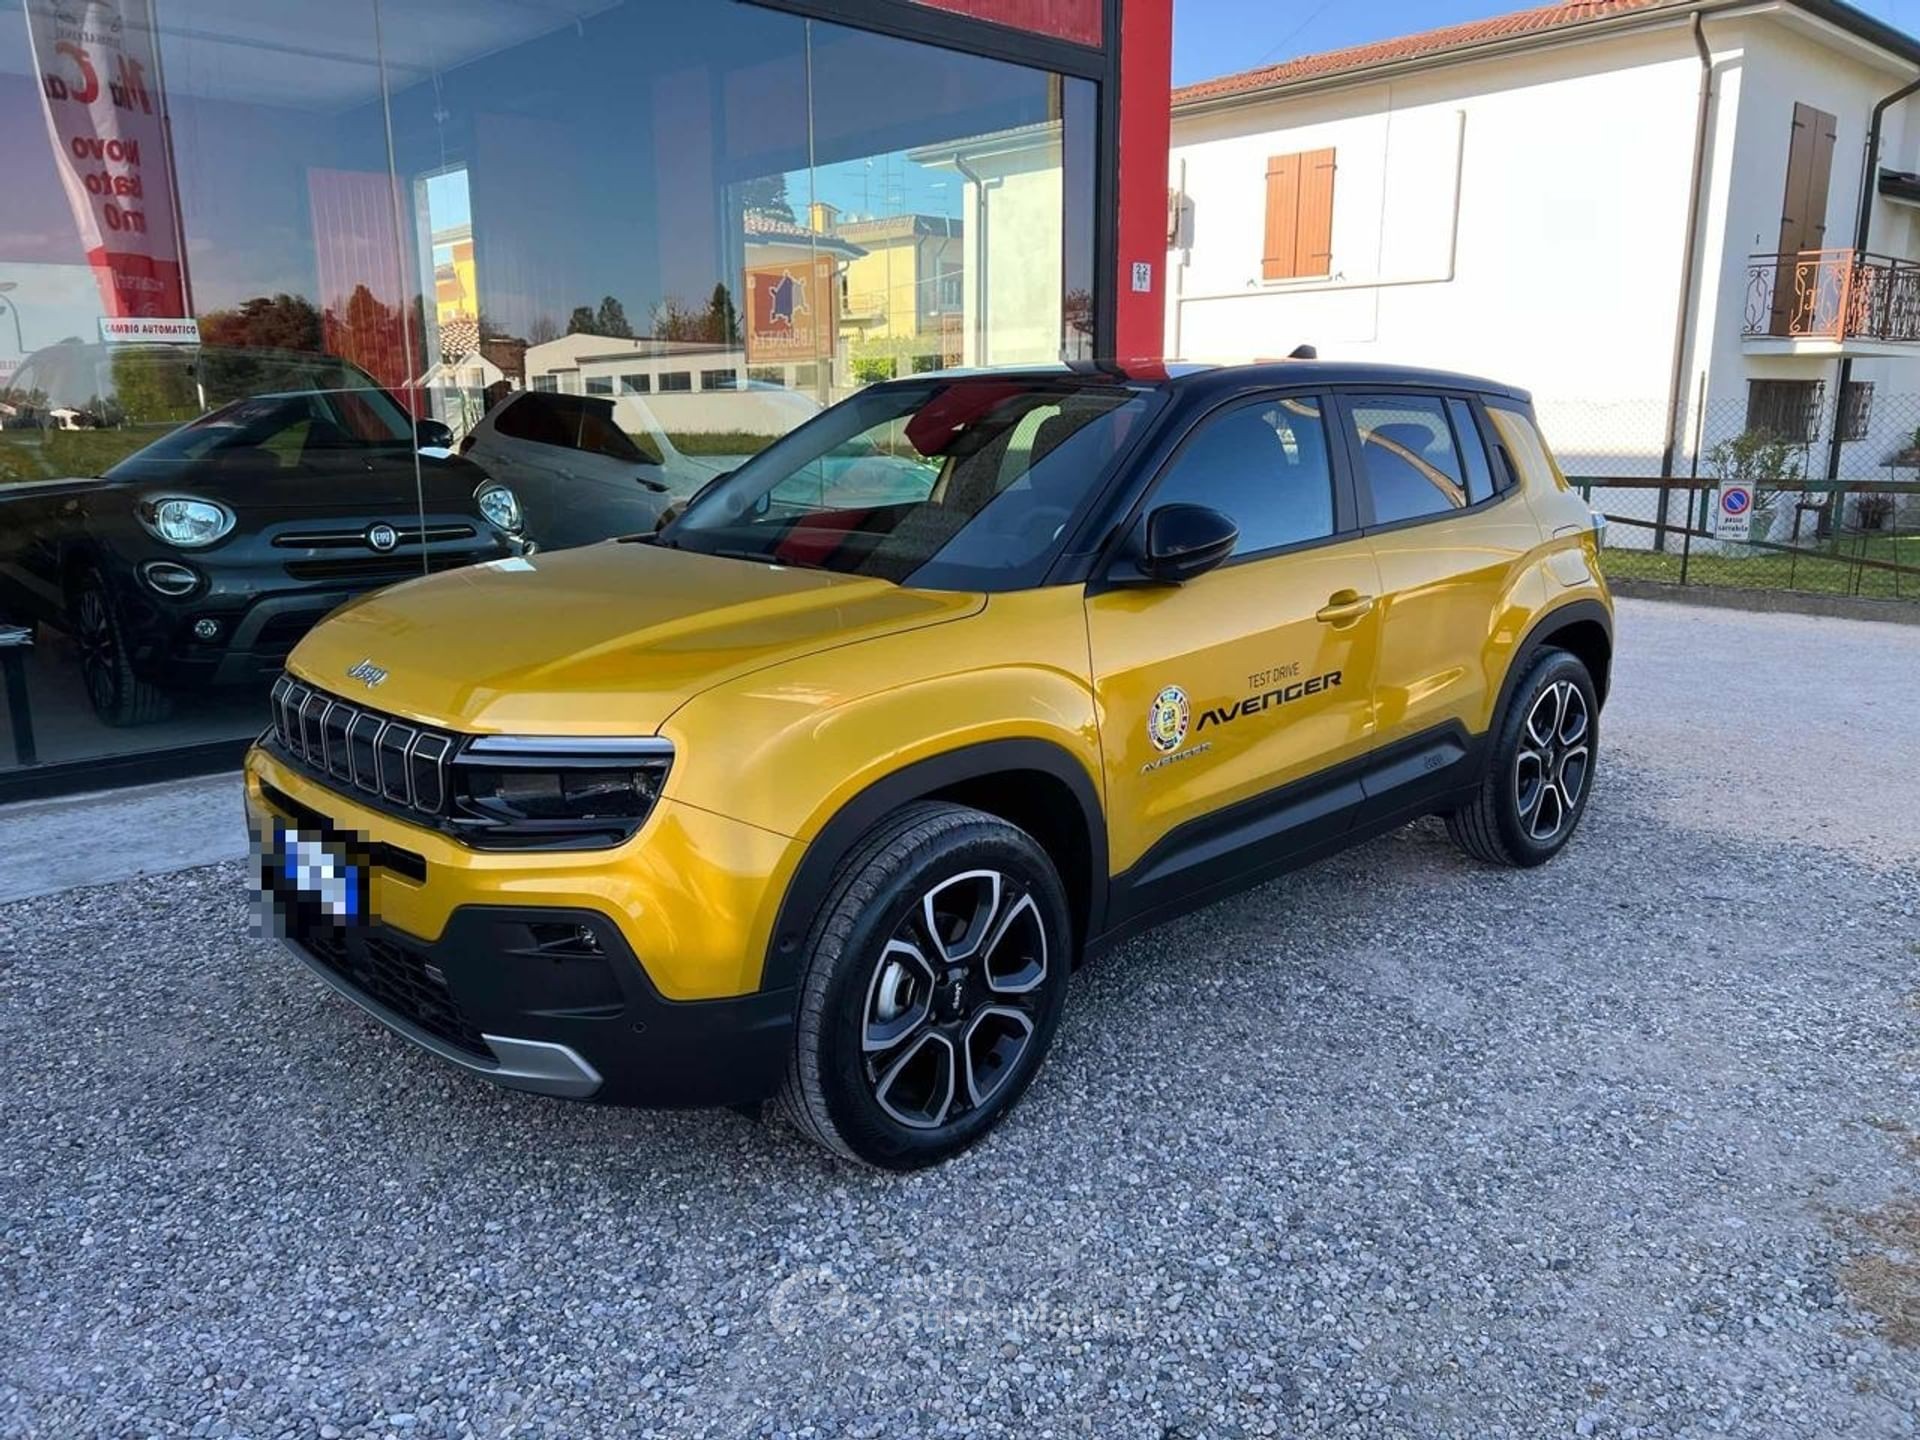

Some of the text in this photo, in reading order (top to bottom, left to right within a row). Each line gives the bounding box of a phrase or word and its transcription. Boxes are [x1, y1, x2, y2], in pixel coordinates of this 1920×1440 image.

[104, 323, 197, 335] CAMBIO AUTOMATICO
[349, 658, 388, 688] Jeep
[1248, 661, 1301, 690] TEST DRIVE
[1196, 670, 1343, 732] AVENGER
